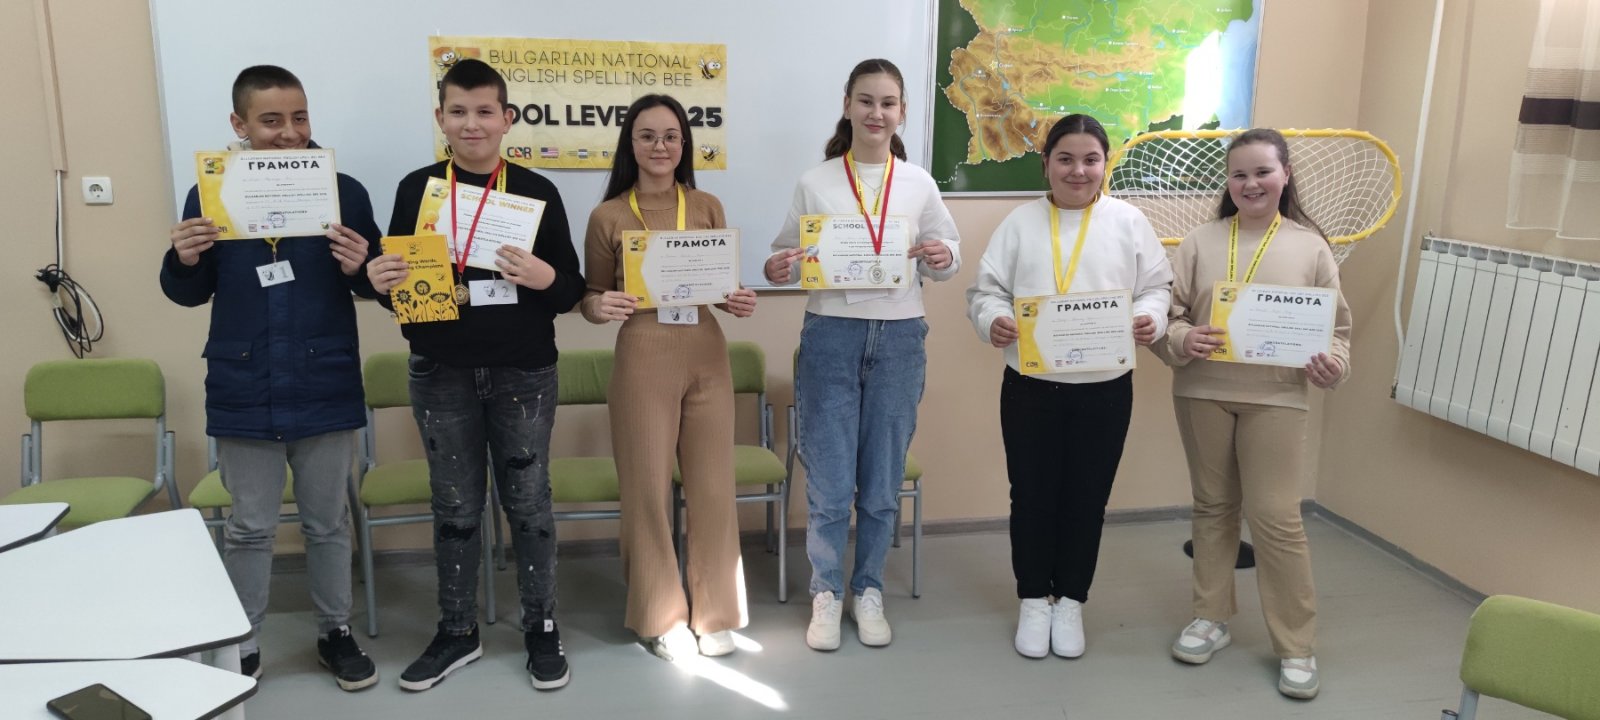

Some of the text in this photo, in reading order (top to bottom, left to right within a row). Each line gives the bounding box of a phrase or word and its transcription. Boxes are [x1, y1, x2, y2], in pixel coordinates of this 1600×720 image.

[489, 49, 692, 69] BULGARIAN NATIONAL
[500, 67, 693, 87] NGLISH SPELLING BEE
[565, 102, 629, 127] LEVE
[248, 160, 320, 171] ГРАМОТА
[499, 201, 535, 213] WINNER
[666, 238, 726, 248] ГРАМОТА
[502, 286, 510, 297] 2
[1257, 293, 1322, 306] ГРАМОТА
[1057, 300, 1118, 312] ГРАМОТА
[686, 311, 694, 322] 6
